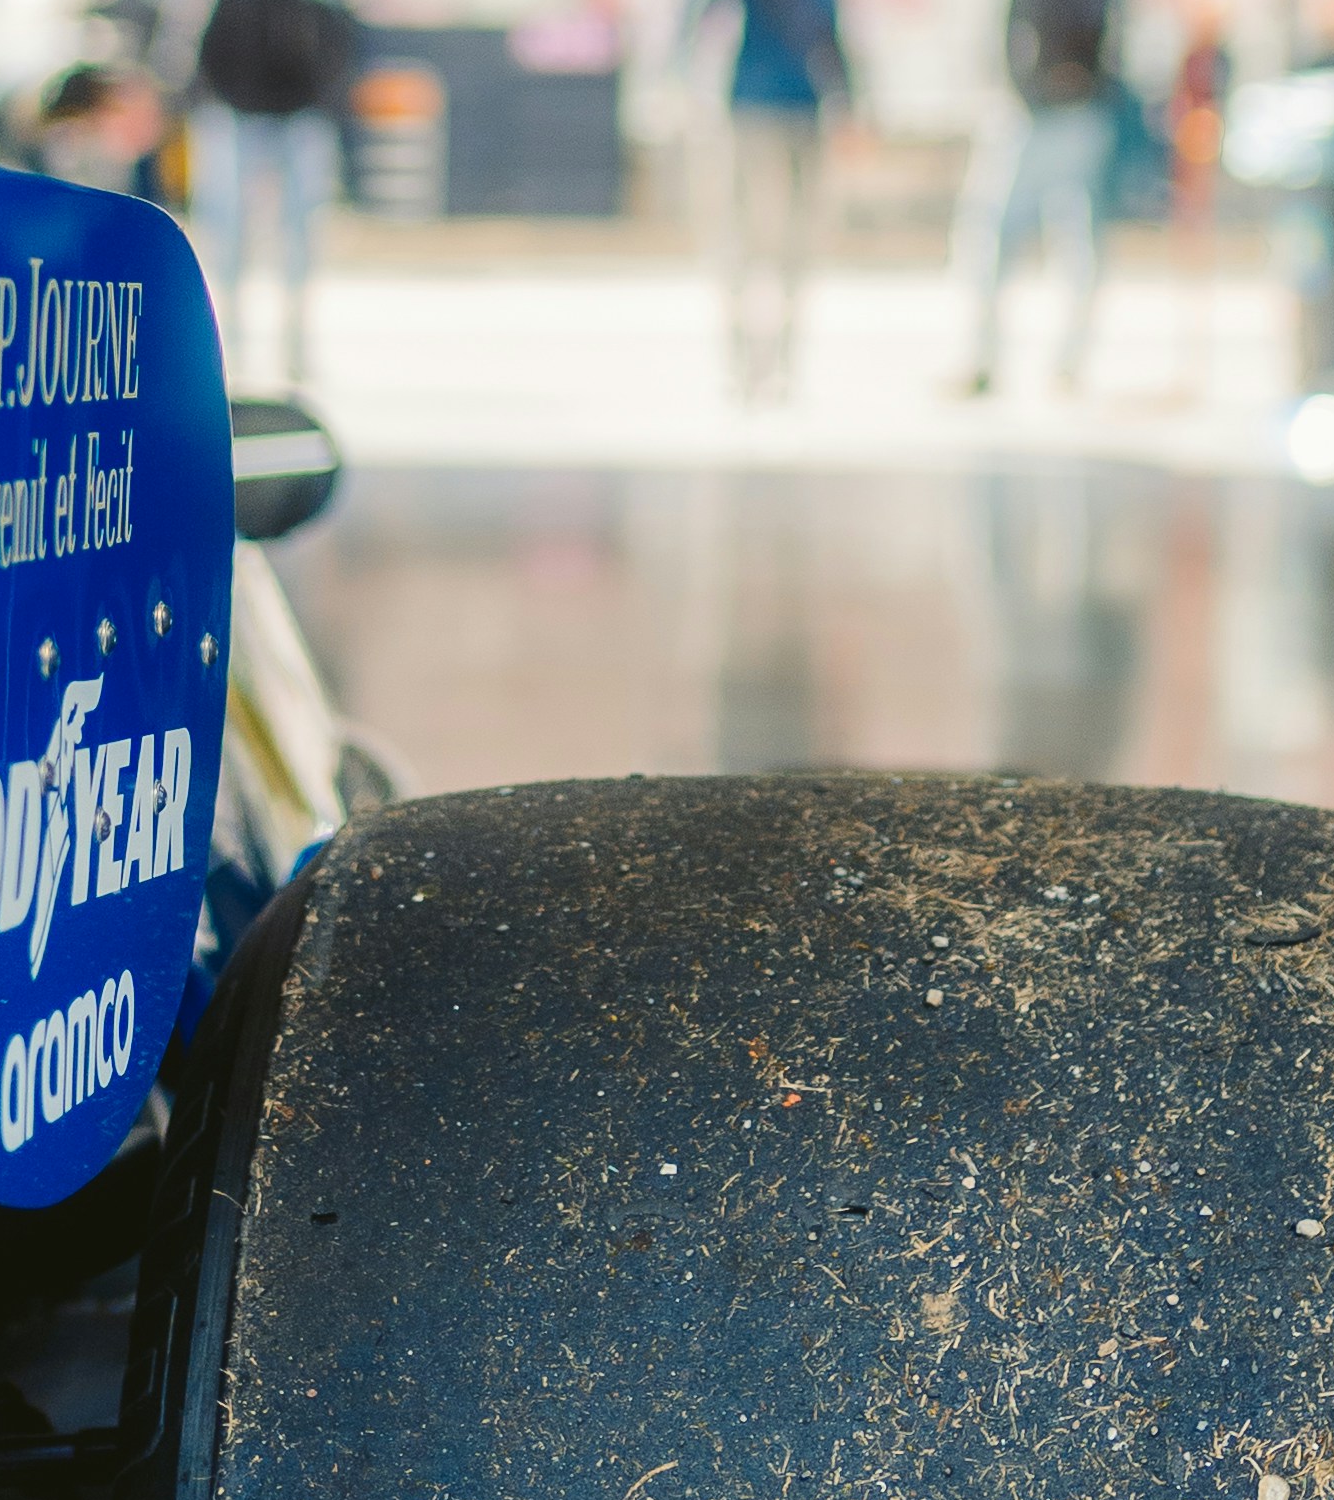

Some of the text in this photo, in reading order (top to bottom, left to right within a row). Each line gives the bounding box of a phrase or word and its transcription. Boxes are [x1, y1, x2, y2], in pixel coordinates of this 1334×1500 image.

[54, 433, 77, 559] et
[82, 428, 134, 551] Fecit
[0, 968, 136, 1153] aramco
